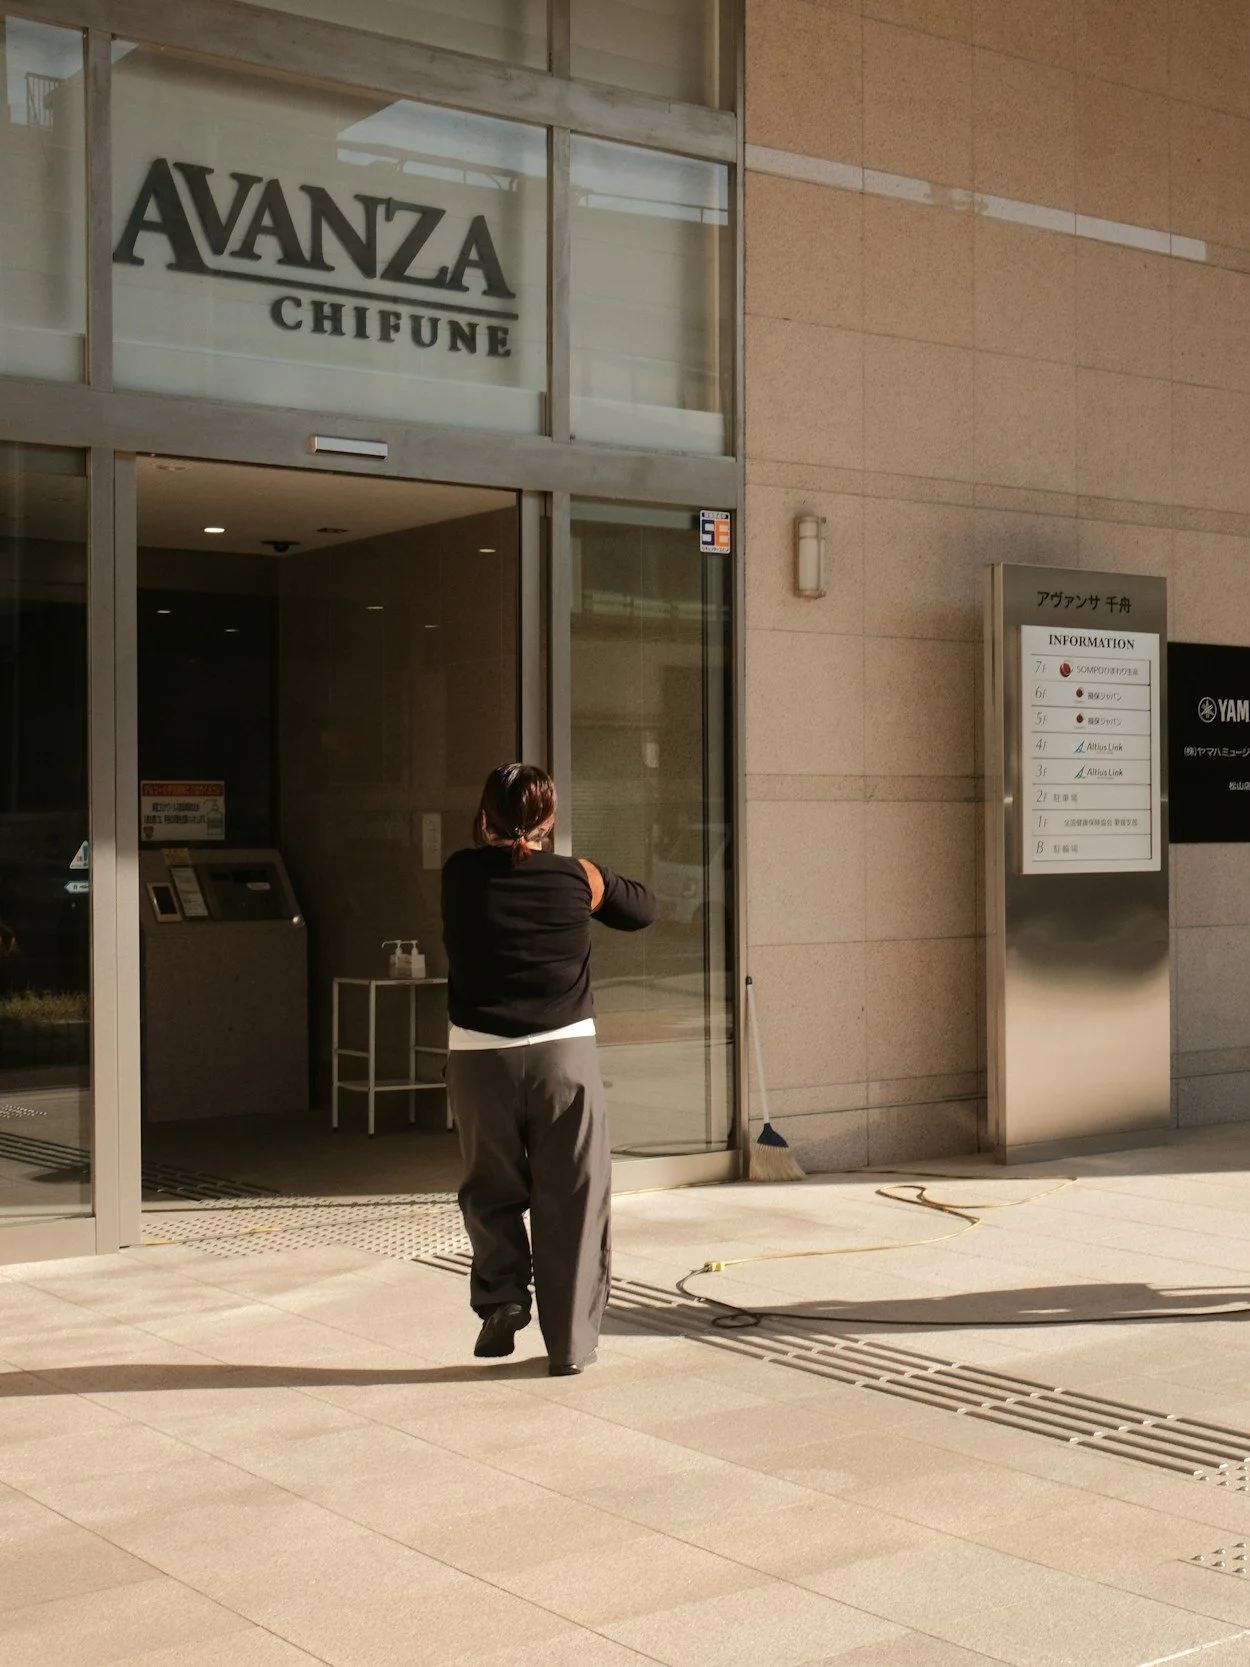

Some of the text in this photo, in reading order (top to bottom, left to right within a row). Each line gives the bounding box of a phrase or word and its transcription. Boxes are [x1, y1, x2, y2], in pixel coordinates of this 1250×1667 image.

[112, 157, 517, 301] AVANZA
[270, 295, 513, 360] CHIFUNE
[1037, 590, 1132, 614] アヴァンサ 千舟
[1049, 633, 1135, 651] INFORMATION
[1086, 742, 1123, 752] Altius Link
[1086, 767, 1123, 777] Altius Link
